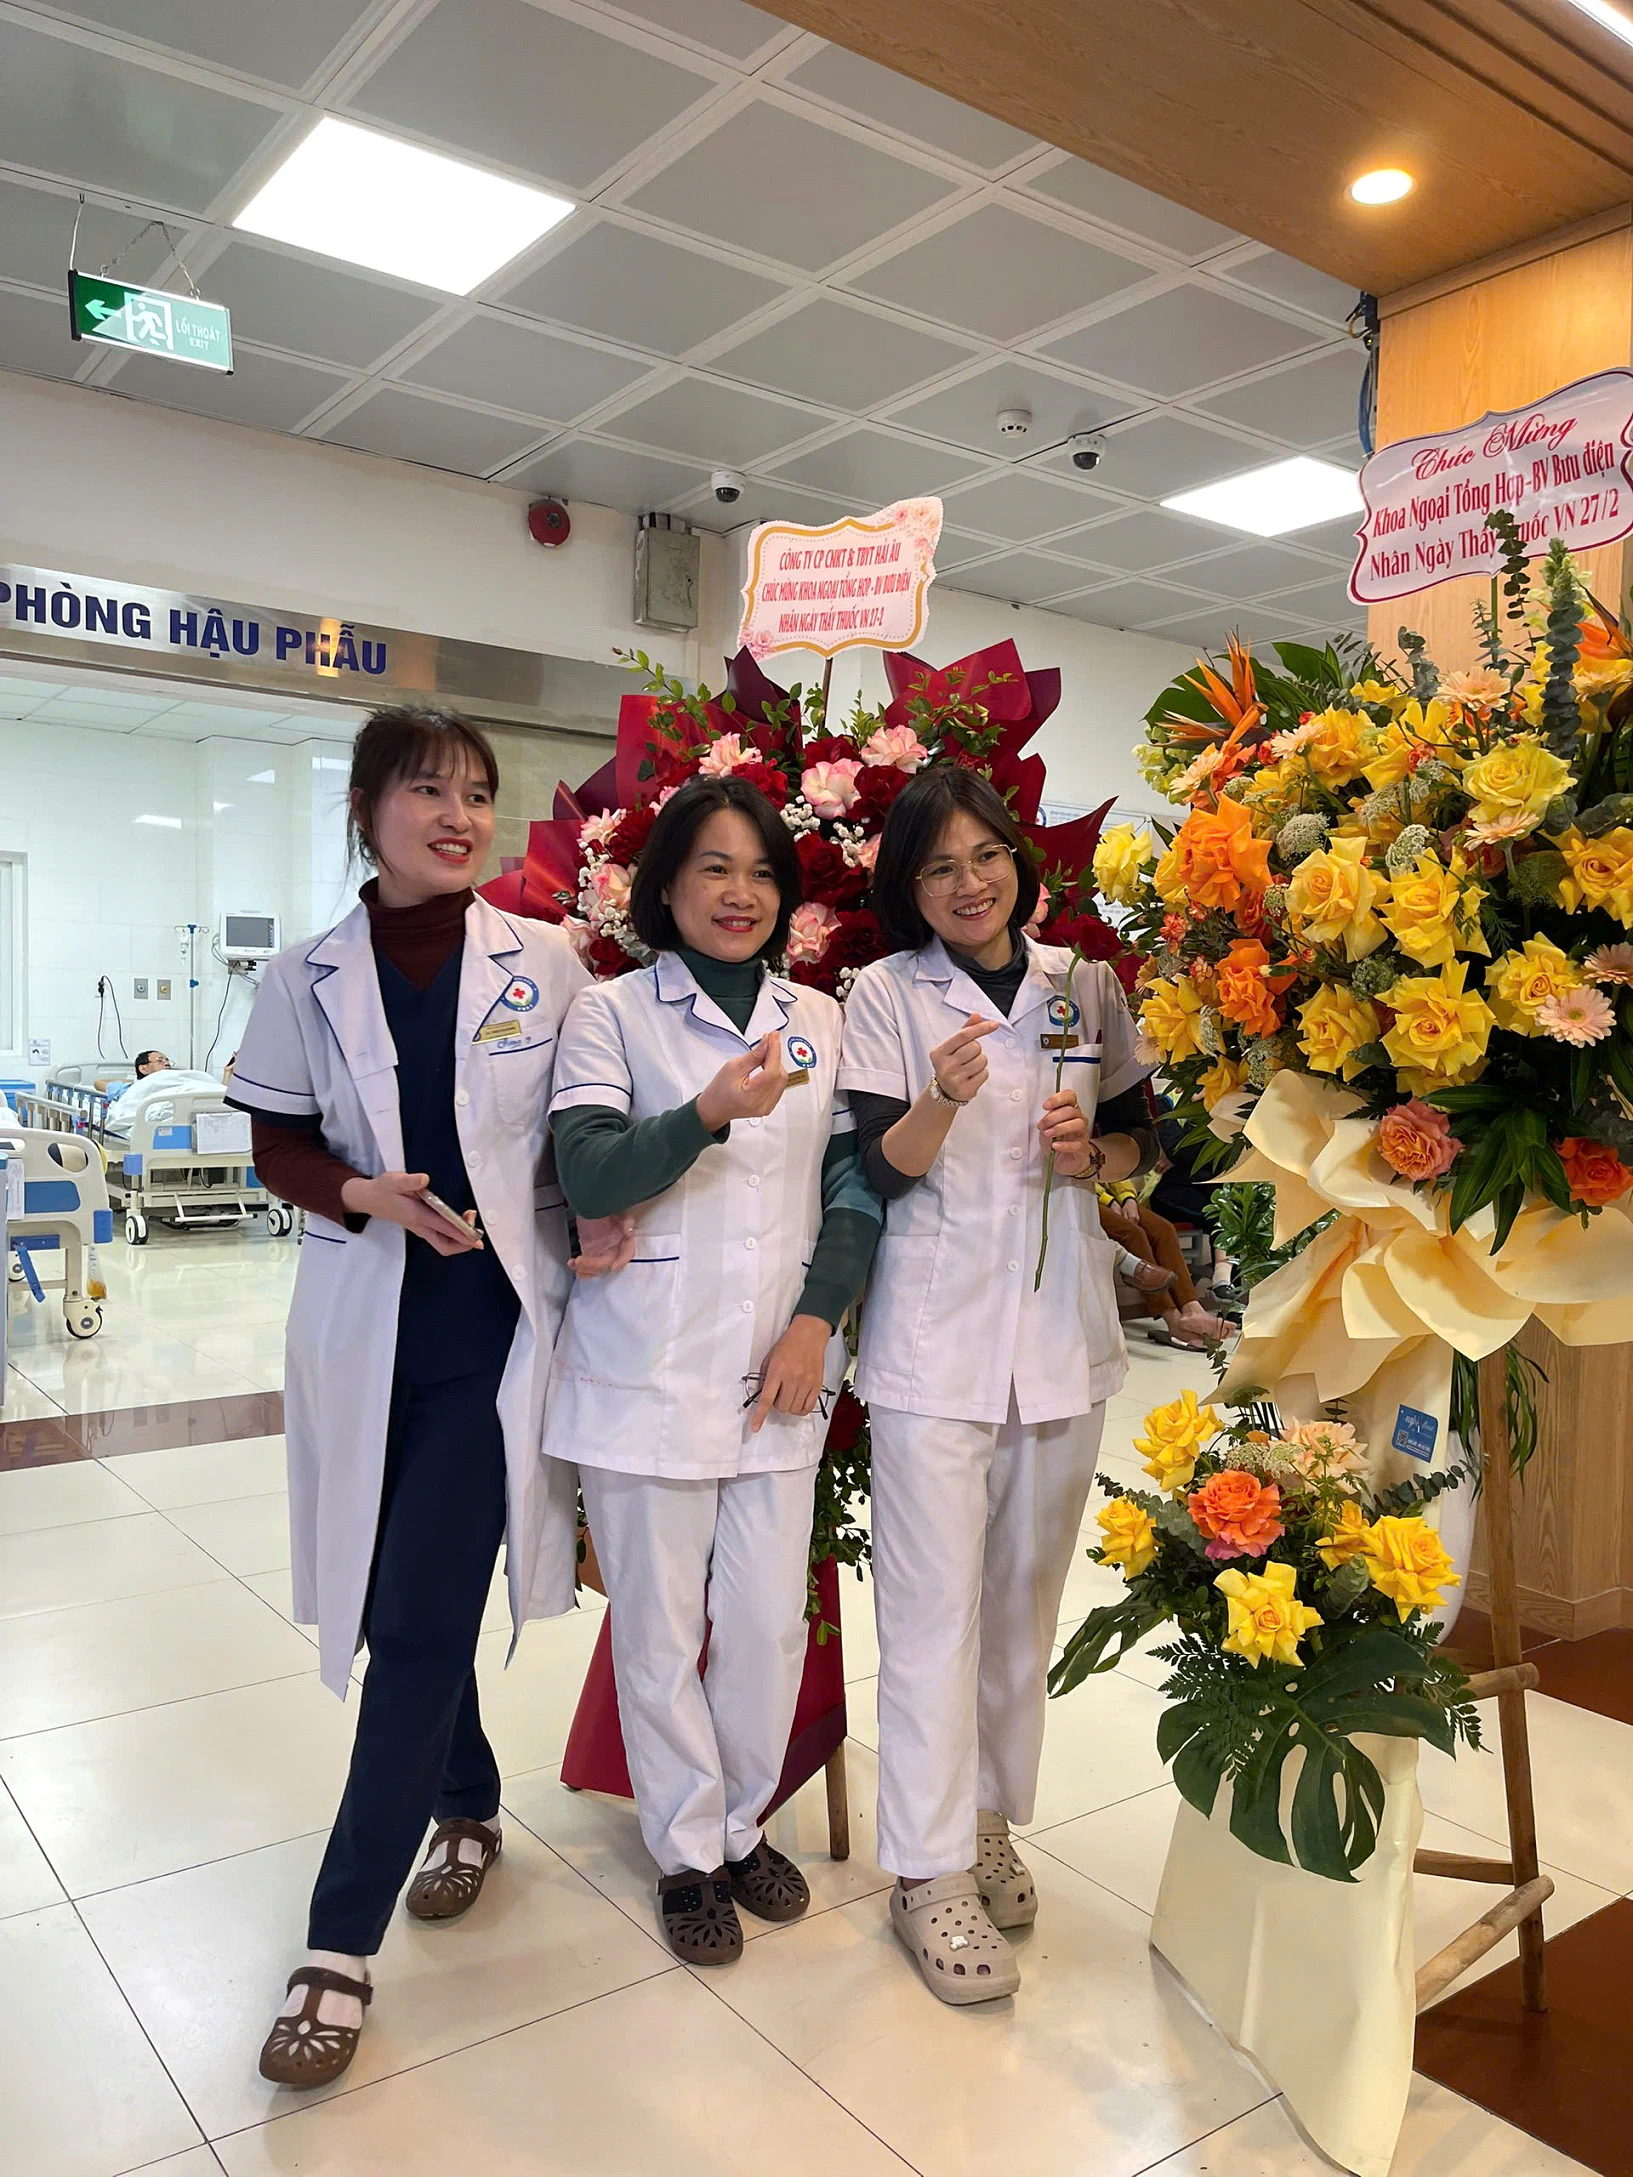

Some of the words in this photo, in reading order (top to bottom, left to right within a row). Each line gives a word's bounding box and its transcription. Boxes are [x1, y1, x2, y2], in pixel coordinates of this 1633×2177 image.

[189, 337, 209, 350] EXIT
[191, 323, 220, 342] THOÁT
[1483, 413, 1578, 458] Mừng
[1372, 508, 1406, 538] Khoa
[1409, 485, 1450, 531] Ngoại
[1454, 478, 1491, 515] Tổng
[1582, 440, 1615, 476] điện
[1370, 549, 1410, 581] Nhân
[1415, 537, 1454, 574] Ngày
[1553, 499, 1577, 533] VN
[1580, 488, 1619, 526] 27/2
[779, 547, 802, 571] CÔNG
[803, 549, 815, 570] TY
[814, 549, 825, 569] CP
[847, 547, 856, 567] &
[169, 608, 260, 658] HẬU
[276, 624, 387, 675] PHẪU
